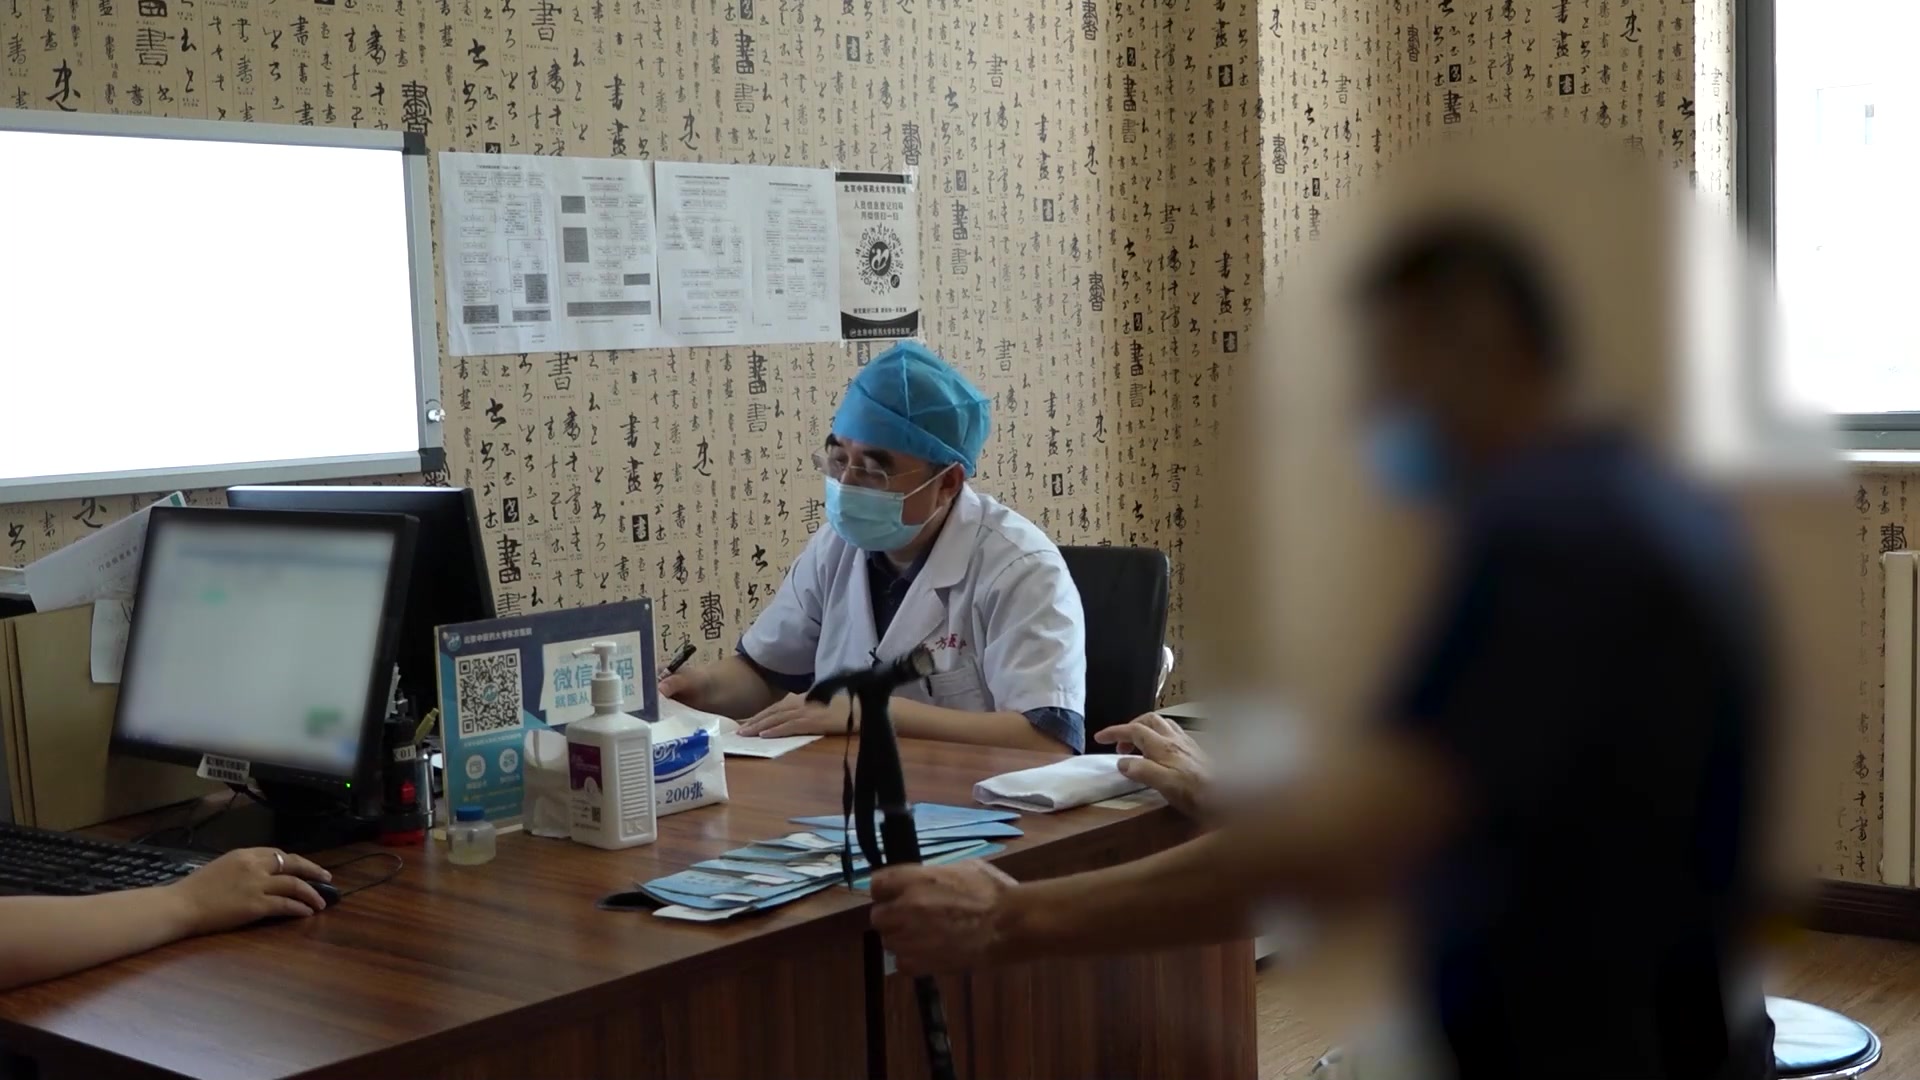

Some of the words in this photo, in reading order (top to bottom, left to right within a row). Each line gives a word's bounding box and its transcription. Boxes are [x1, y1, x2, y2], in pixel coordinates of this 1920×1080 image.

[553, 657, 635, 693] 微信码
[665, 781, 705, 804] 200张
